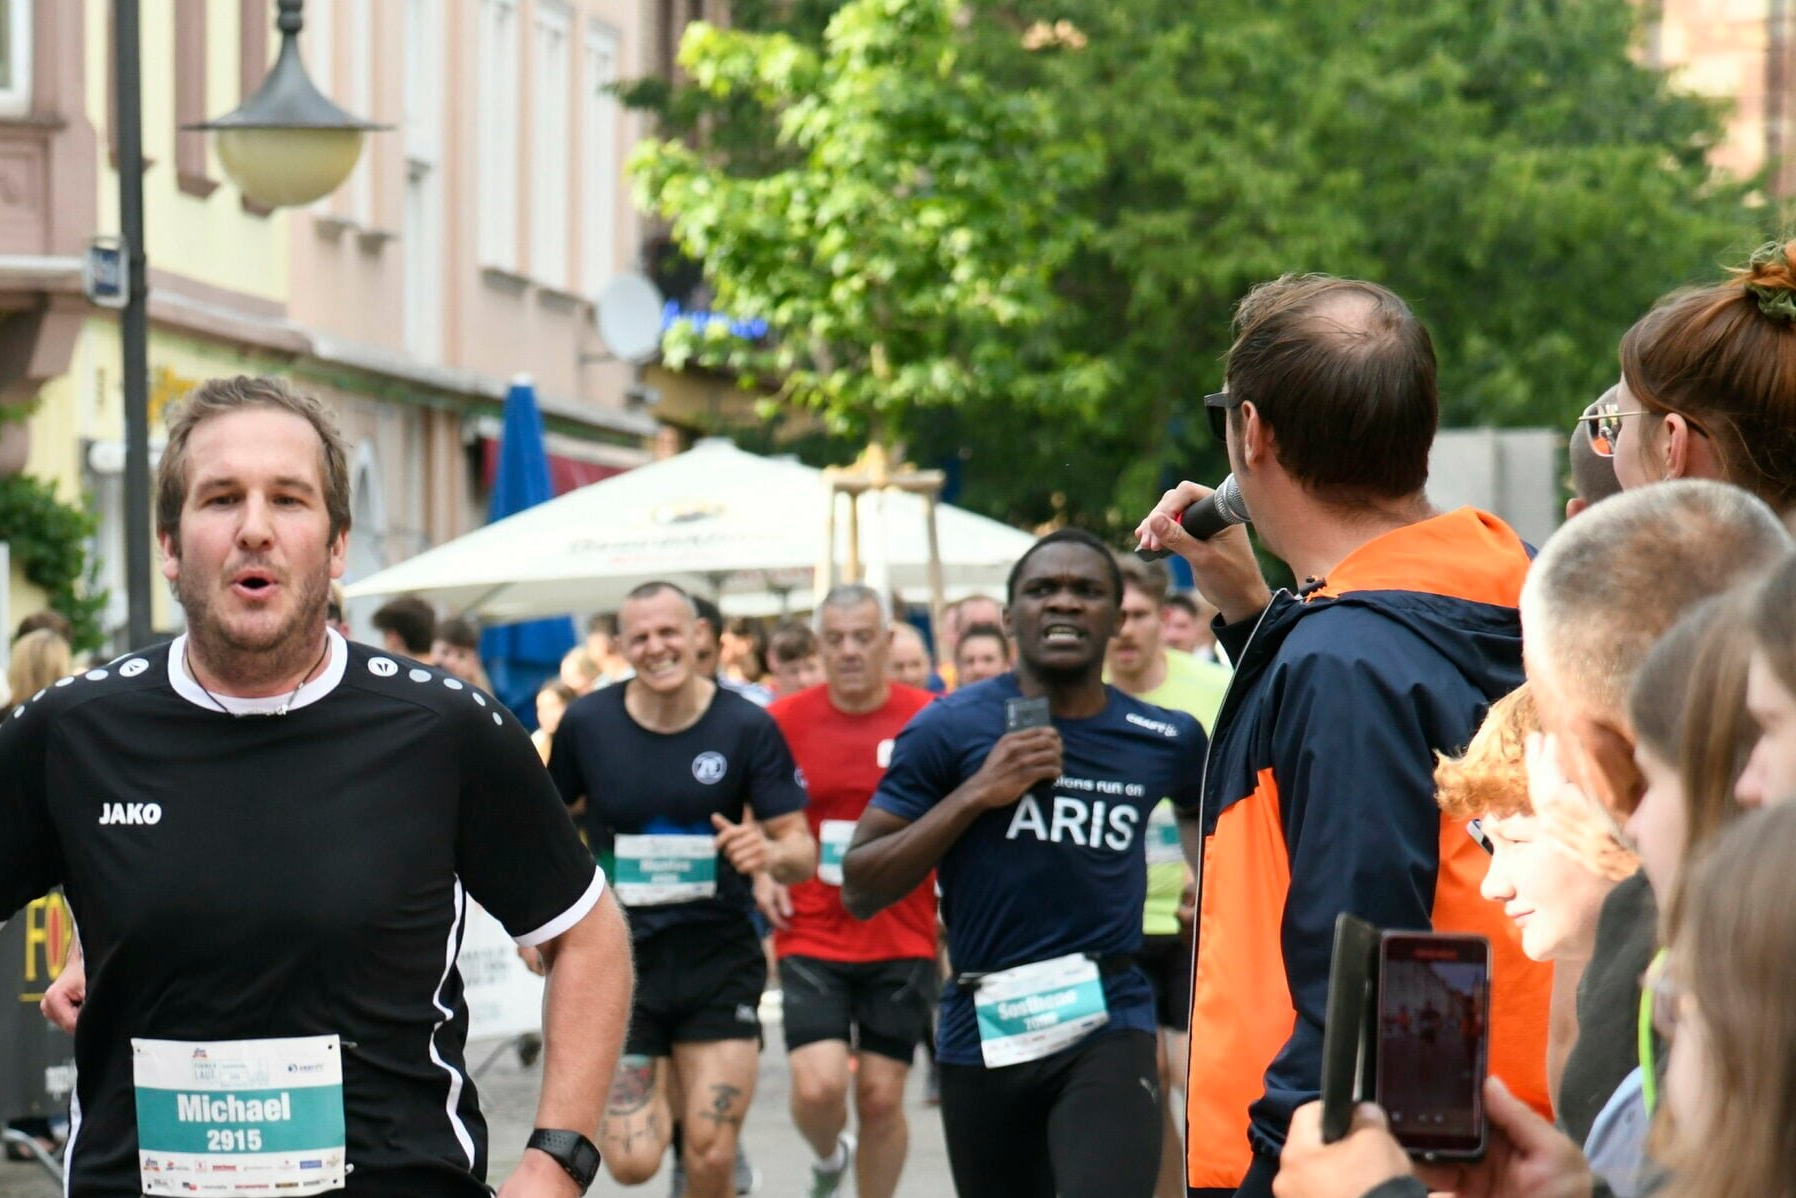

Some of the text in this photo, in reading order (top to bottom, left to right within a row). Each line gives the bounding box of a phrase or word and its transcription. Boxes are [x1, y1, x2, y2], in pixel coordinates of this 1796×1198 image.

[1097, 781, 1122, 795] run
[99, 802, 162, 825] JAKO
[1005, 795, 1140, 851] ARIS
[177, 1091, 292, 1123] Michael
[207, 1129, 263, 1151] 2915
